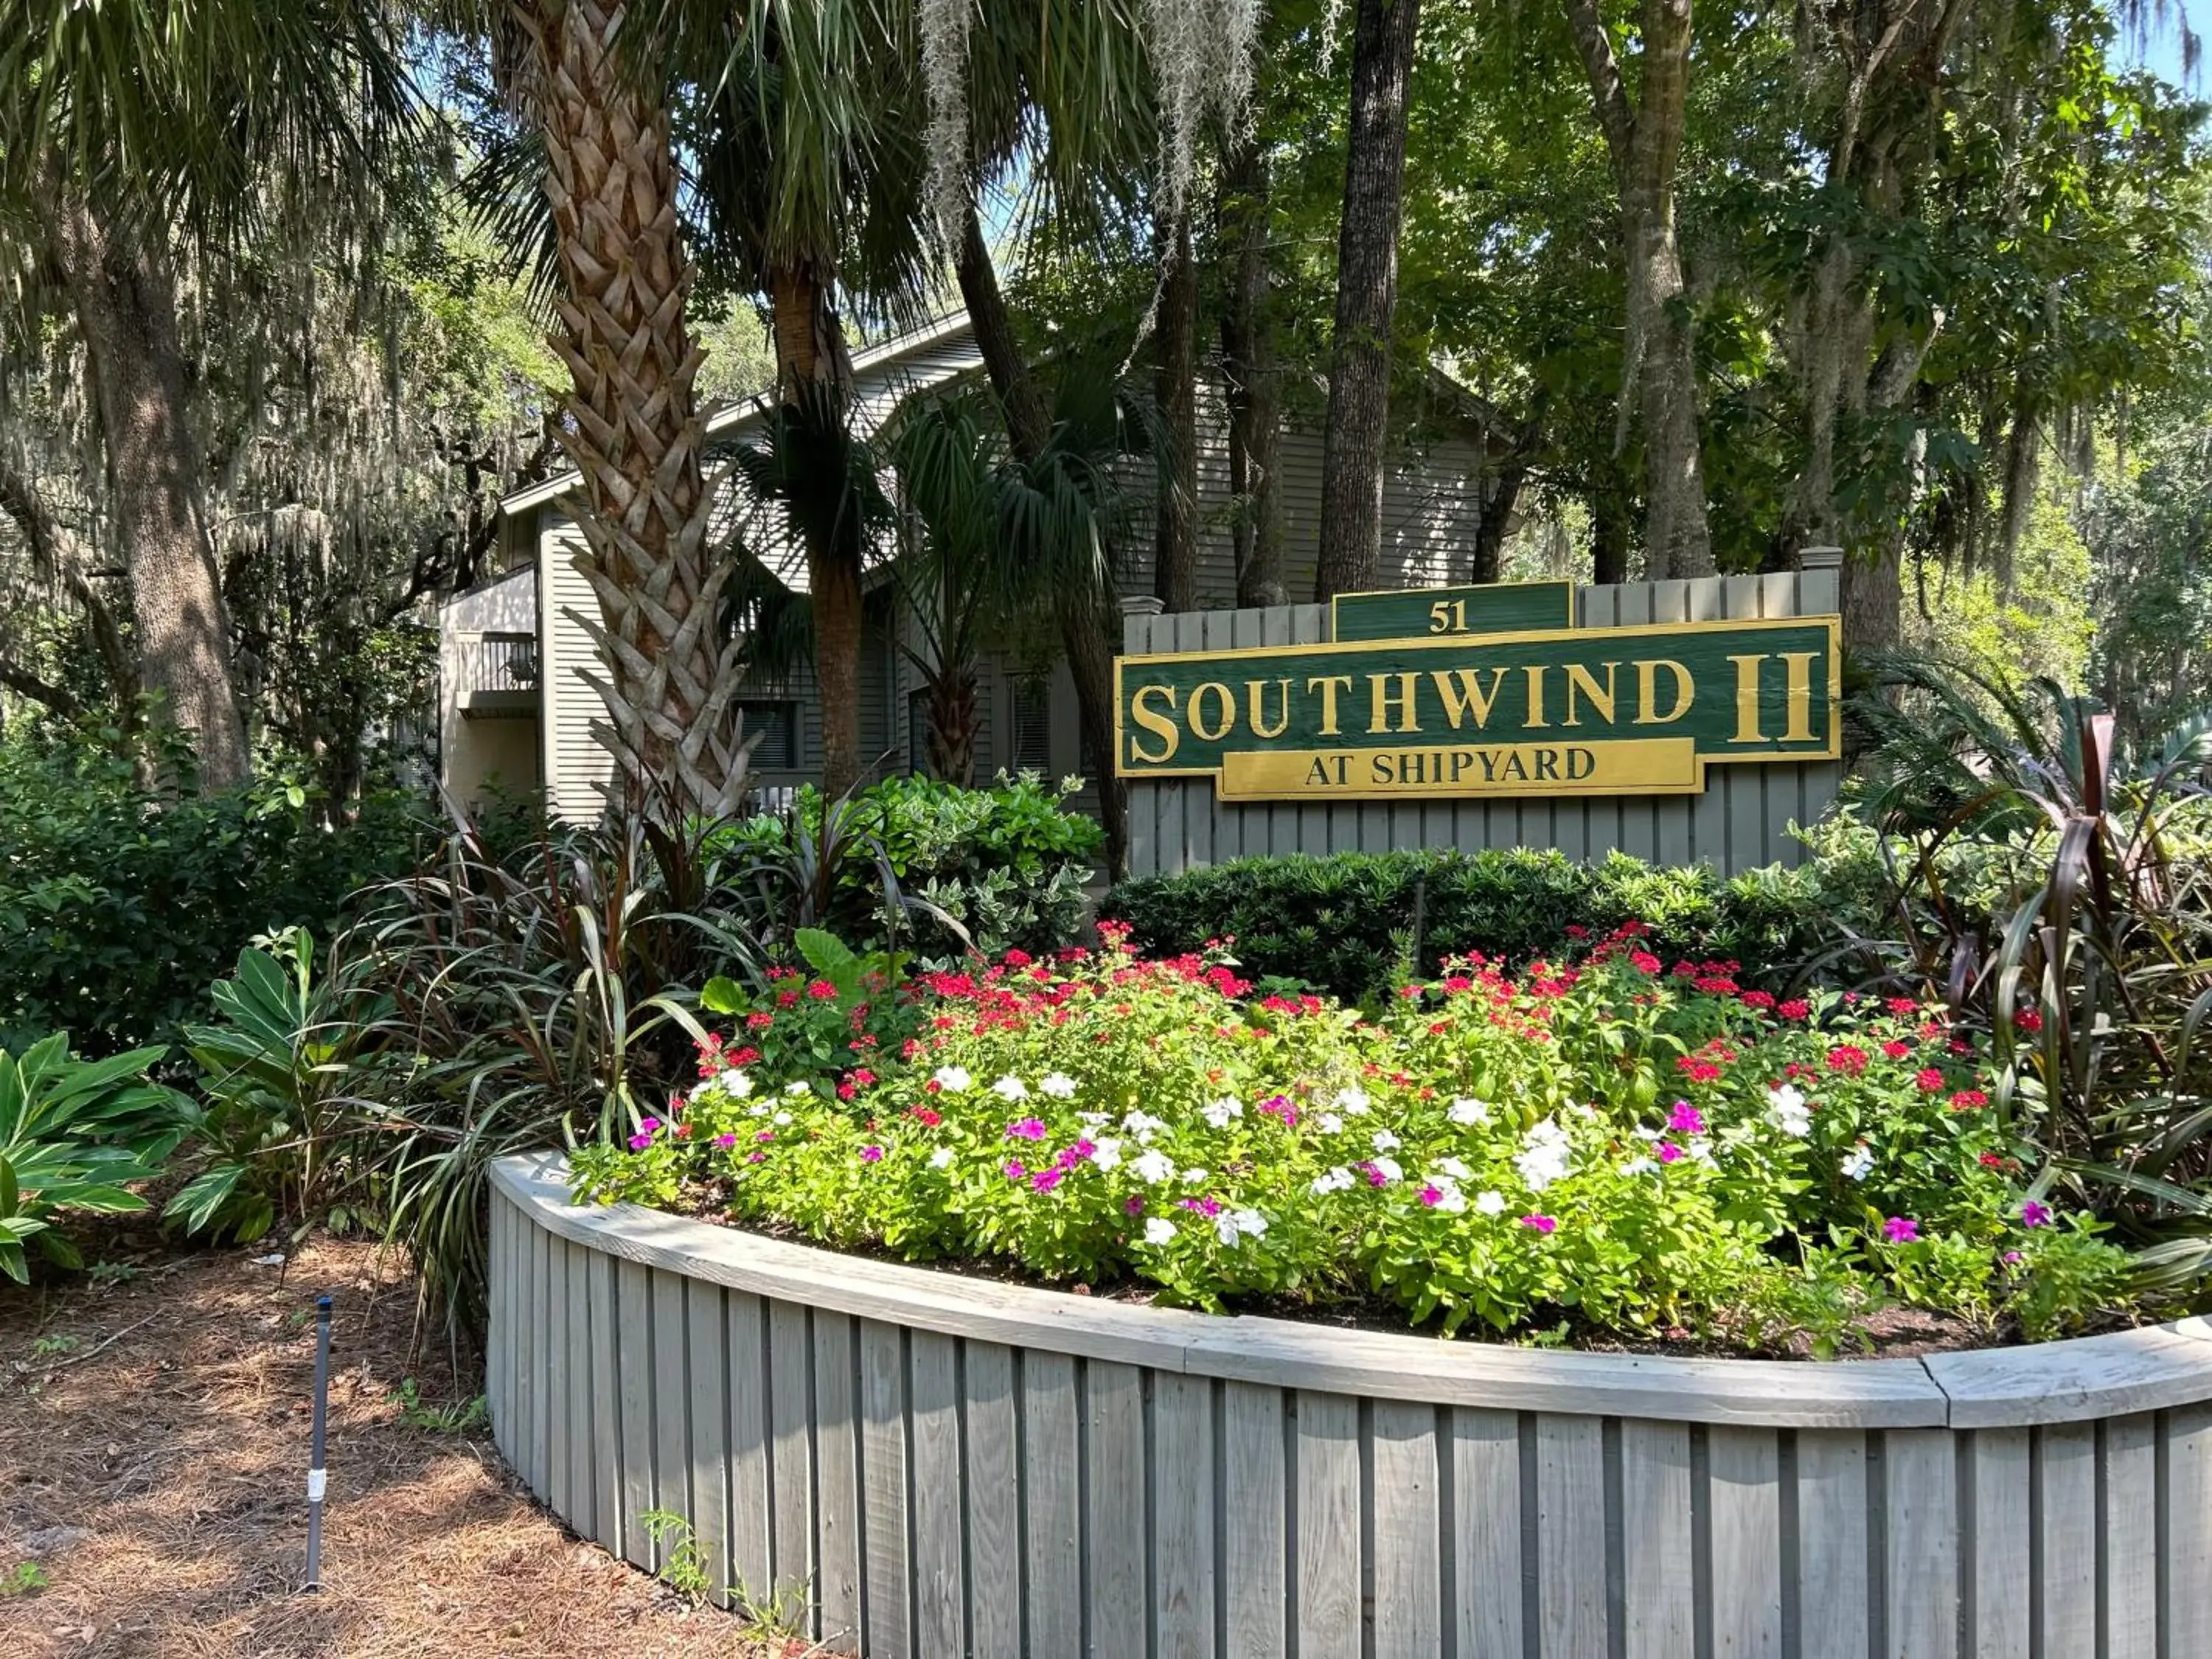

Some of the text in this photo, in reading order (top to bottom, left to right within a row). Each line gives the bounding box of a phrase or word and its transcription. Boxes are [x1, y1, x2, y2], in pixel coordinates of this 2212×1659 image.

[1430, 599, 1470, 632] 51
[1132, 652, 1821, 763] SOUTHWIND II
[1305, 748, 1596, 785] AT SHIPYARD
